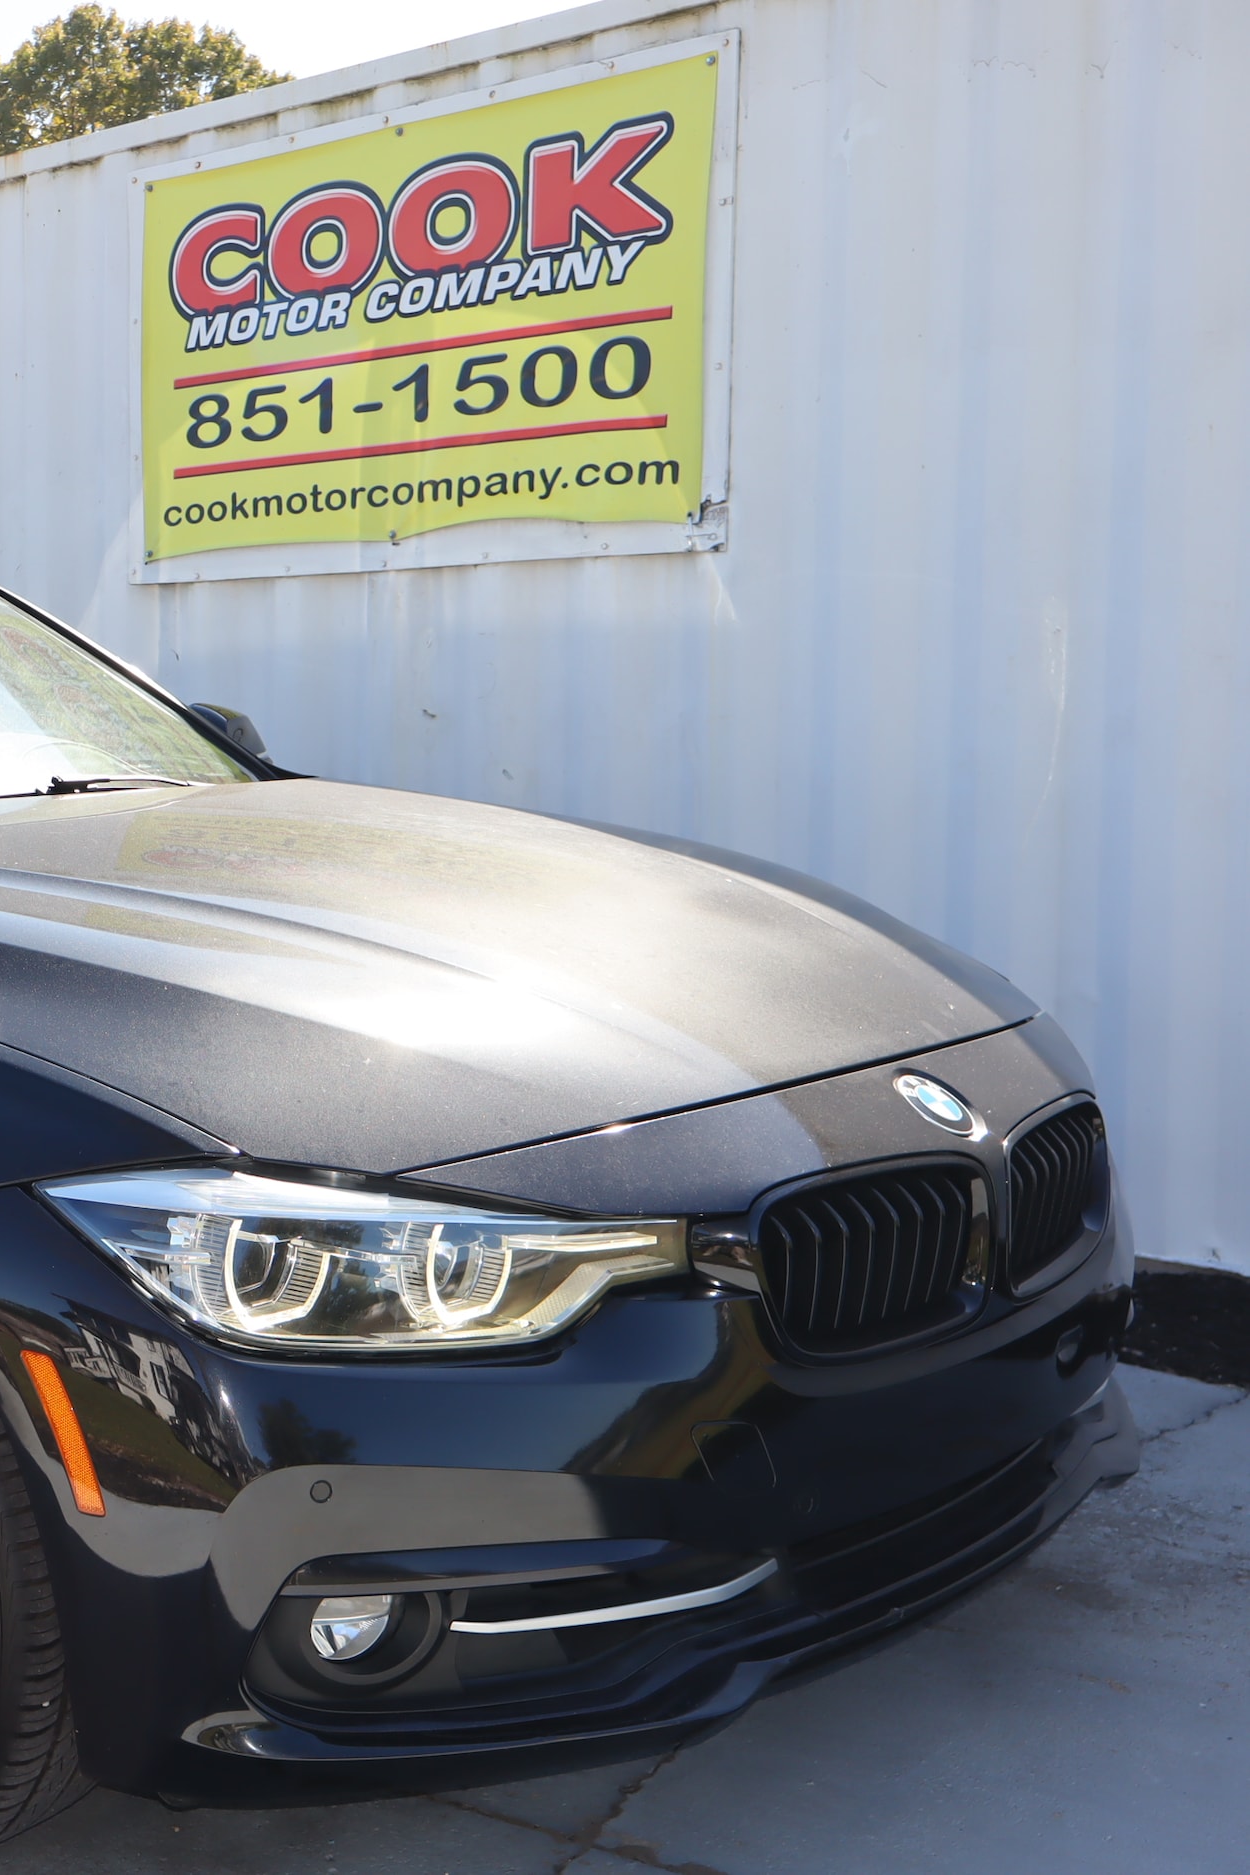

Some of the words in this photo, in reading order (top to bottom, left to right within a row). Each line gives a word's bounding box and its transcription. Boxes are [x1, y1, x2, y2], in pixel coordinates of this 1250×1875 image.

[170, 110, 673, 315] COOK
[186, 292, 351, 352] MOTOR
[365, 240, 646, 322] COMPANY
[185, 336, 651, 449] 851-1500
[163, 459, 680, 527] cookmotorcompany.com
